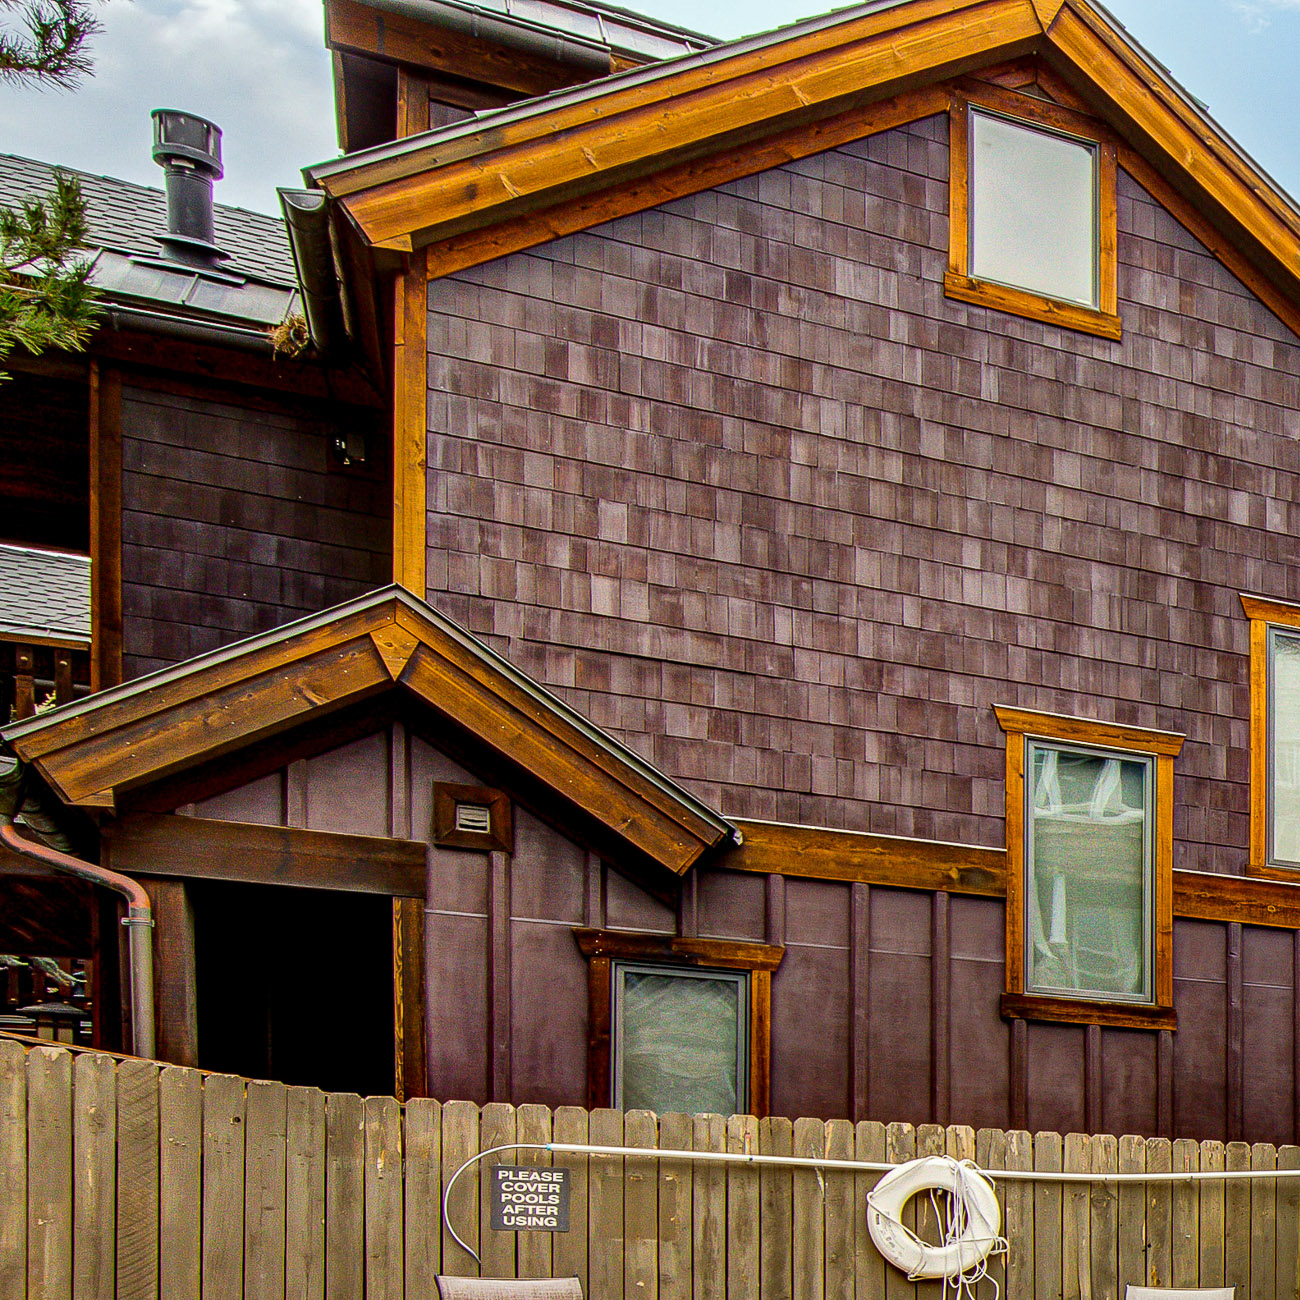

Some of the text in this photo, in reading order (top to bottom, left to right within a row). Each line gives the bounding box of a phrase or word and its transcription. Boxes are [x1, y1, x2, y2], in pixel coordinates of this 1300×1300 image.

[498, 1170, 564, 1182] PLEASE
[501, 1181, 560, 1193] COVER
[501, 1193, 560, 1205] POOLS
[502, 1204, 559, 1216] AFTER
[503, 1215, 558, 1227] USING
